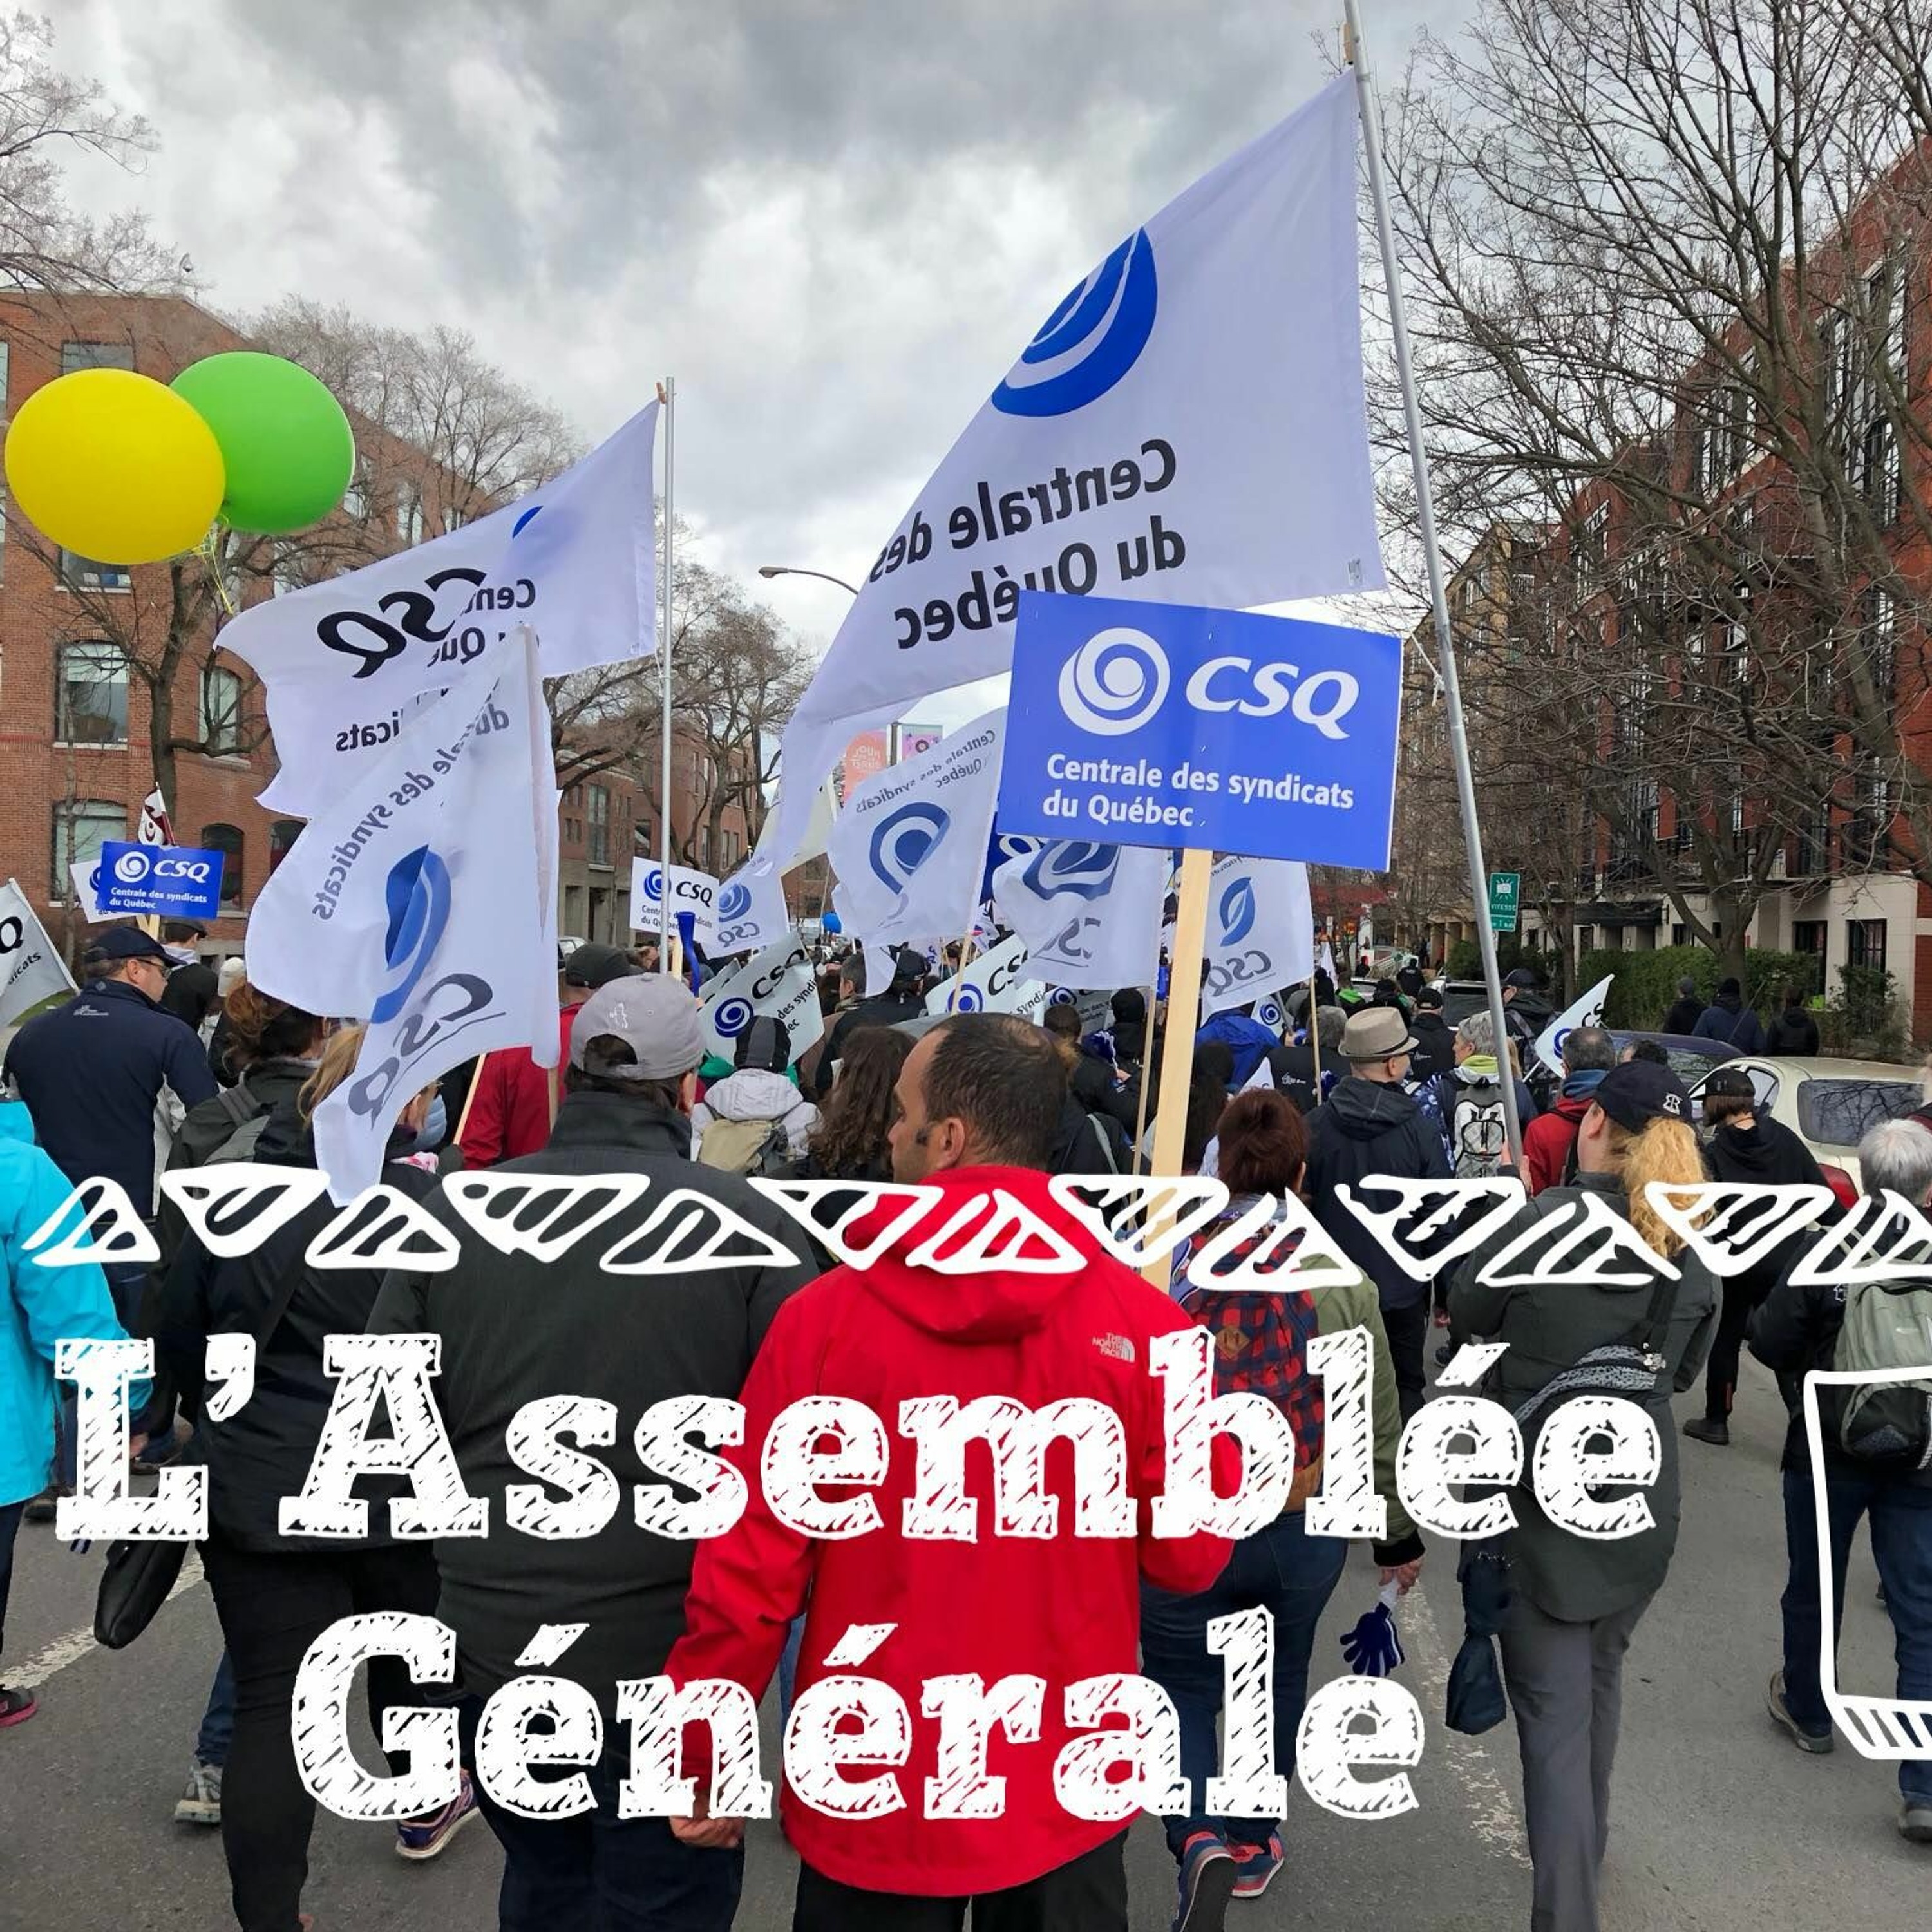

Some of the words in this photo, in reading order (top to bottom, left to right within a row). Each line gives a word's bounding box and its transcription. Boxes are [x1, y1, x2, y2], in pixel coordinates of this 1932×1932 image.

[1186, 656, 1359, 740] CSQ
[1046, 753, 1162, 788] Centrale
[1171, 761, 1220, 793] des
[1228, 773, 1354, 810] syndicats
[1042, 788, 1079, 819] du
[1087, 794, 1195, 828] Québec
[153, 859, 211, 884] CSQ
[109, 896, 122, 907] du
[123, 897, 156, 909] Québec
[110, 886, 147, 898] Centrale
[149, 890, 165, 899] des
[166, 892, 207, 904] syndicats
[676, 880, 713, 907] CSQ
[777, 1002, 795, 1019] des
